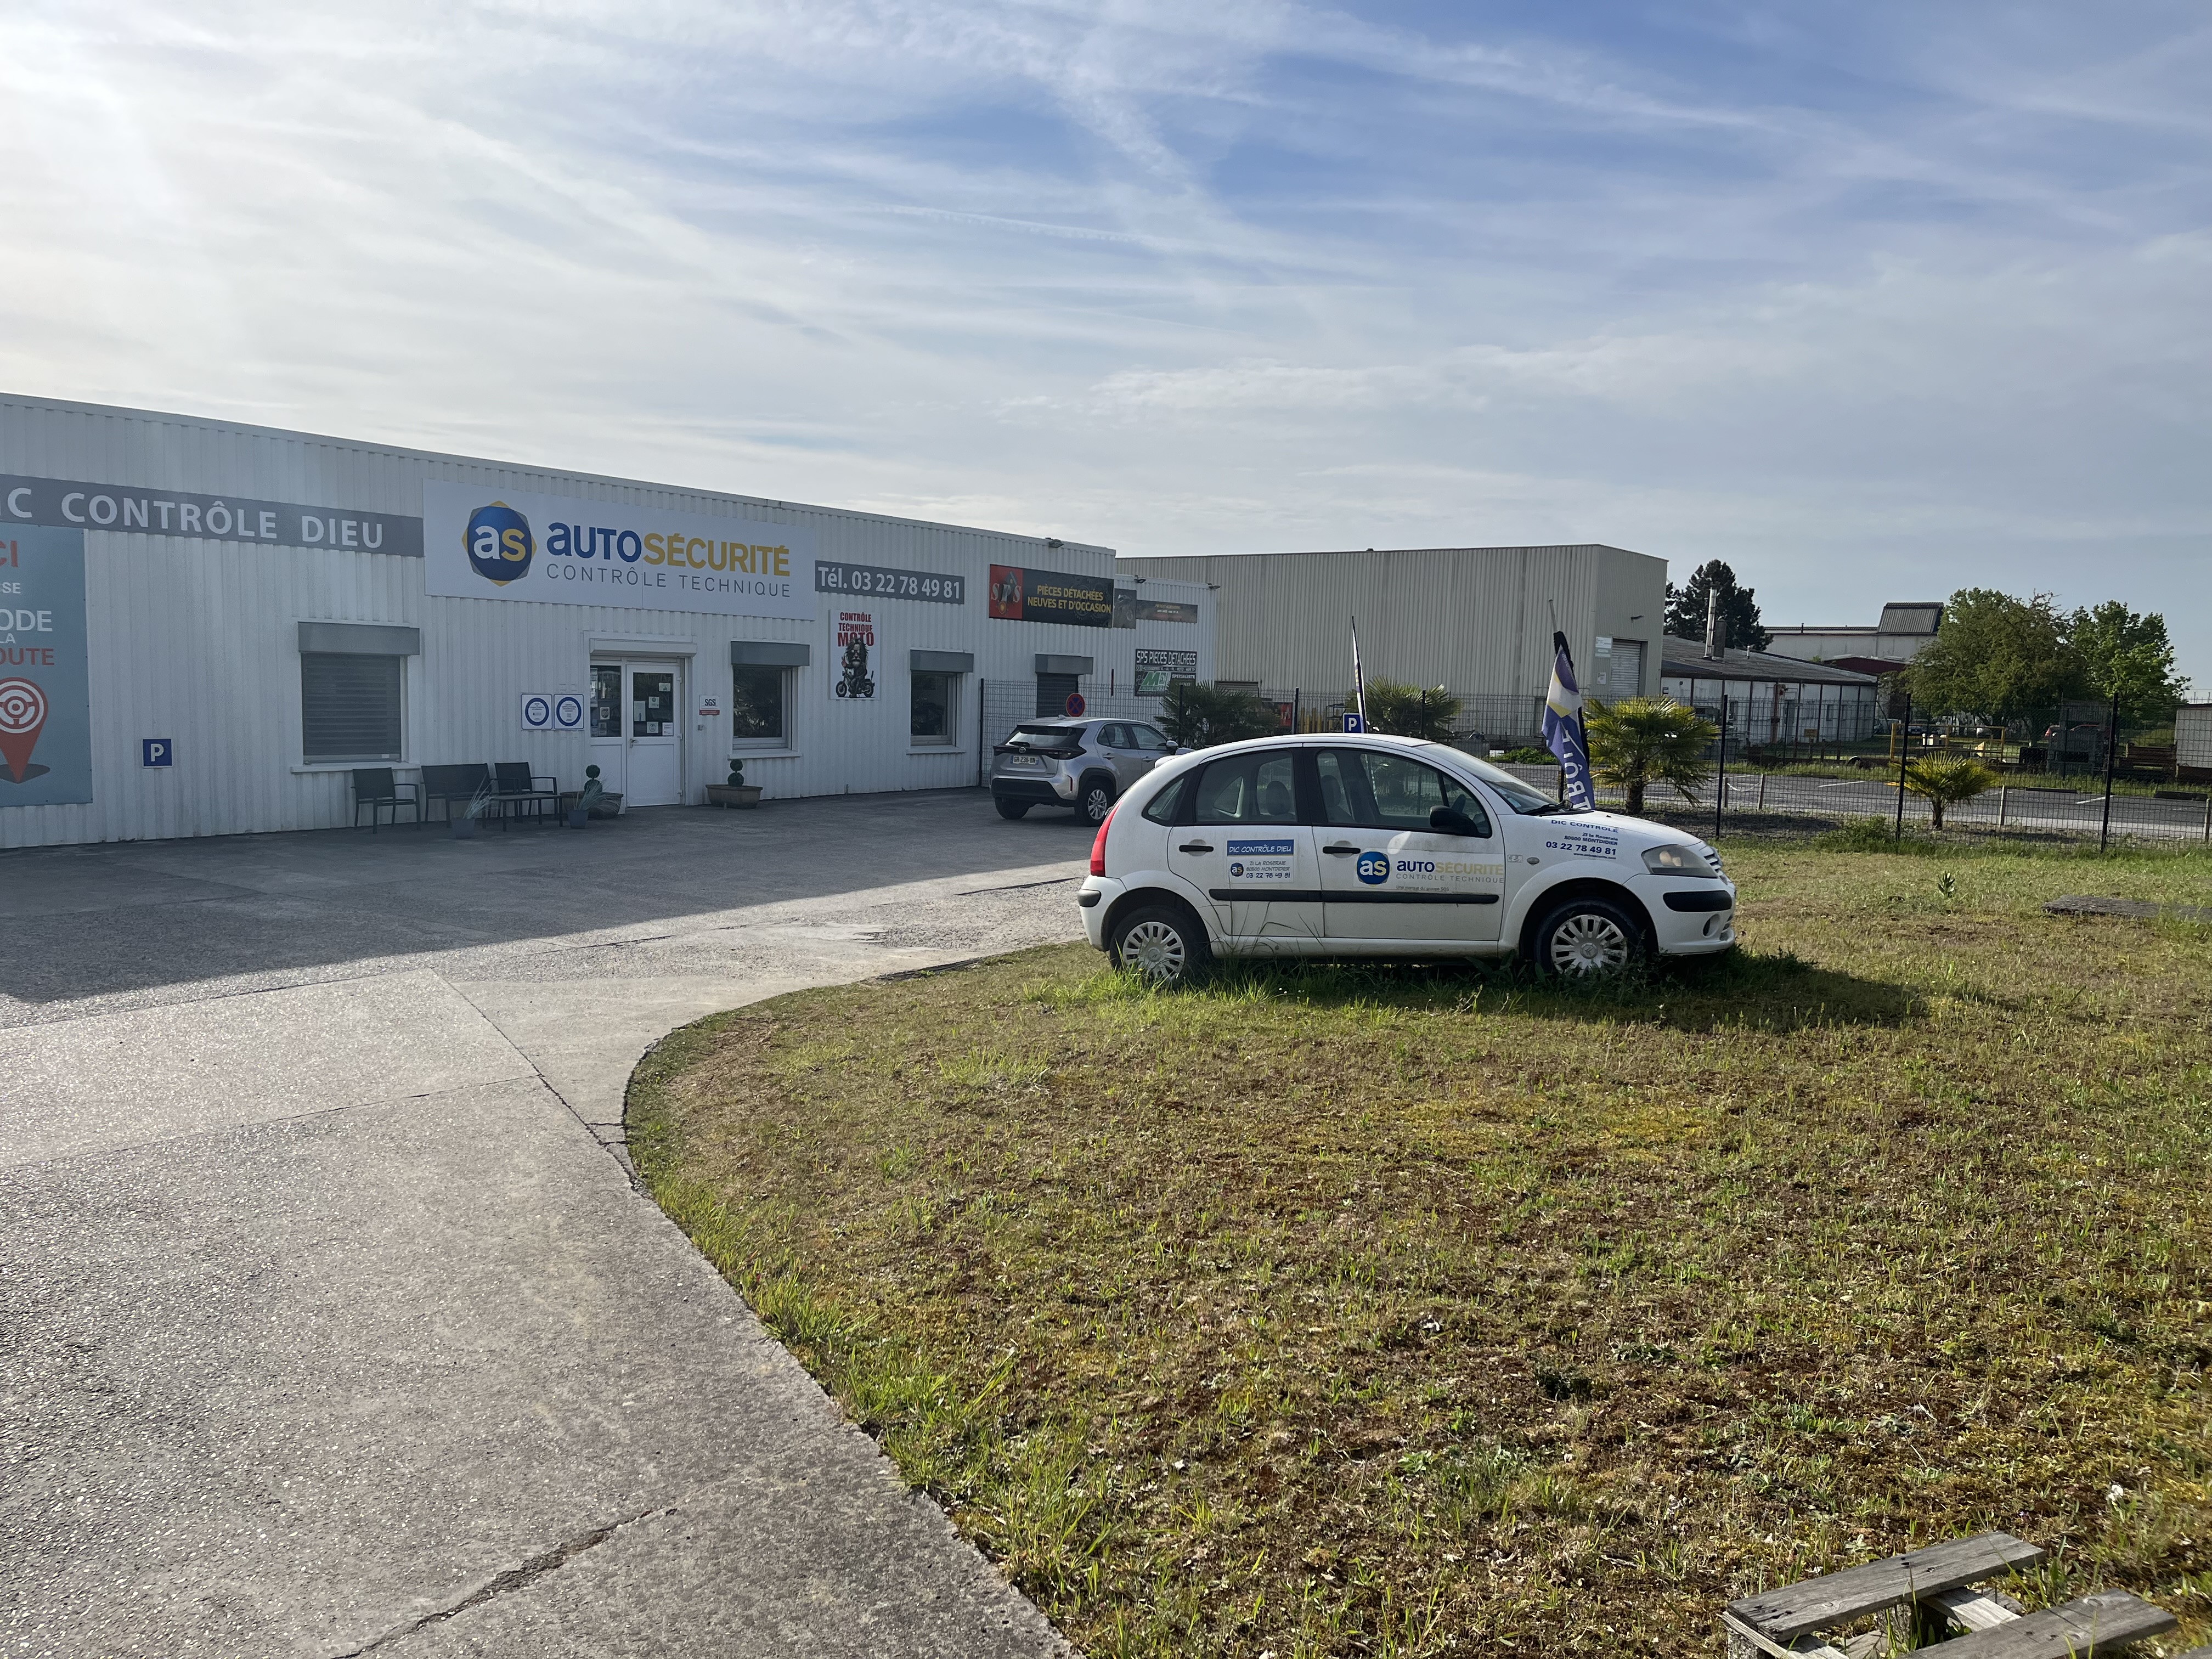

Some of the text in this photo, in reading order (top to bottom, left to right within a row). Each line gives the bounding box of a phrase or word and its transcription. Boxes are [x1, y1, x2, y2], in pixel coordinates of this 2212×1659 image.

[0, 487, 382, 549] C CONTRÔLE DIEU
[473, 525, 526, 562] as
[546, 563, 791, 597] CONTRÔLE TECHNIQUE
[817, 566, 960, 599] Tél. 03 22 78 49 81
[1037, 584, 1103, 601] PIÈCES DÉTACHÉES
[1027, 596, 1111, 614] NEUVES ET D'OCCASION
[840, 612, 872, 623] CONTRÔLE
[838, 623, 873, 633] TECHNIQUE
[1136, 650, 1196, 665] SPS PIECES DETACHEES
[704, 698, 716, 707] SGS
[1348, 717, 1358, 731] P
[150, 743, 164, 762] P
[1241, 844, 1275, 853] CONTRÔLE
[1560, 843, 1572, 851] 22
[1582, 837, 1618, 845] MONTDIDIER
[1359, 860, 1387, 876] as
[1396, 873, 1504, 884] CONTRÔLE TECHNIQUE
